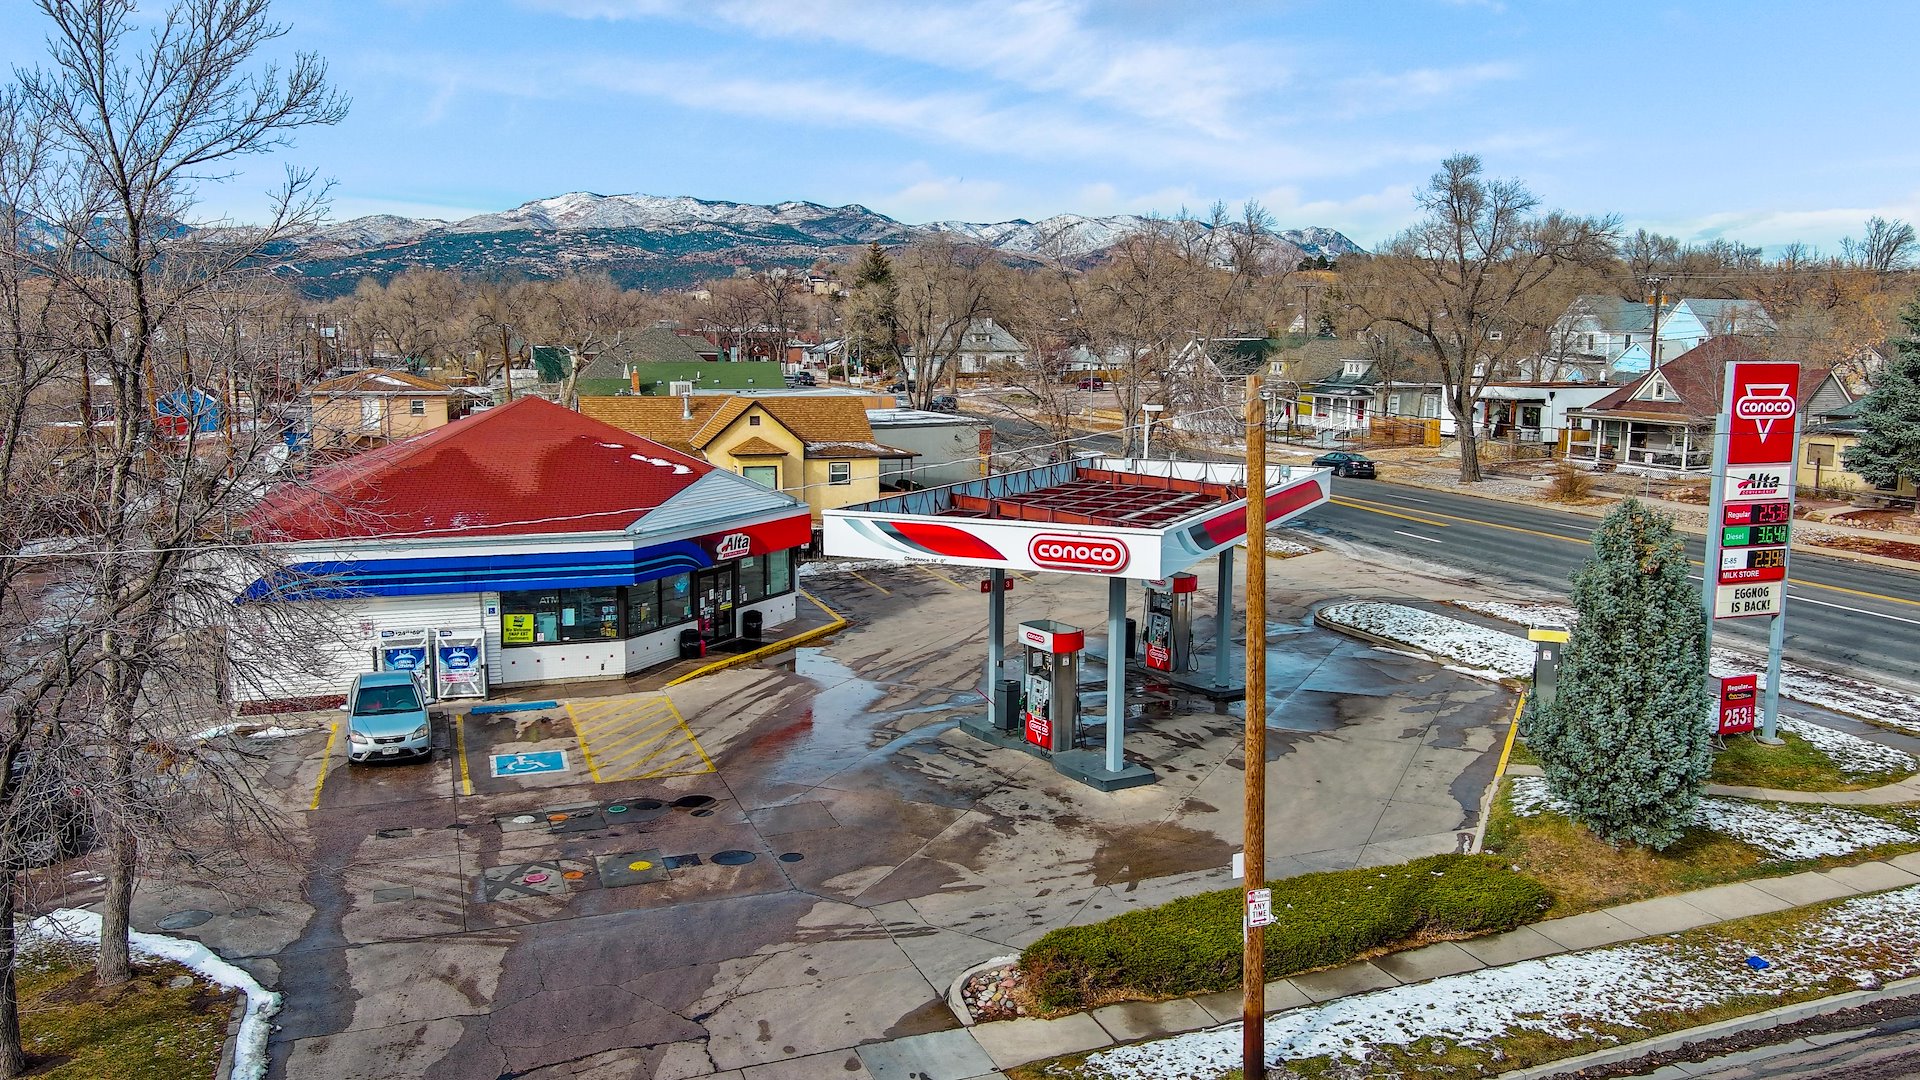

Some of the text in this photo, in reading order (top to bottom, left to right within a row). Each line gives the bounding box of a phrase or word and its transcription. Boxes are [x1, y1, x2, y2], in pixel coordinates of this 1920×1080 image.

[1738, 473, 1780, 489] Alta
[1727, 511, 1751, 519] Regular
[721, 535, 749, 552] Alta
[1723, 557, 1738, 565] E-85
[1722, 570, 1760, 579] MILK STORE
[1734, 586, 1770, 600] EGGNOG
[539, 596, 560, 604] ATM
[1731, 600, 1771, 613] IS BACK!
[1724, 707, 1747, 727] 253
[1252, 910, 1267, 918] TIME
